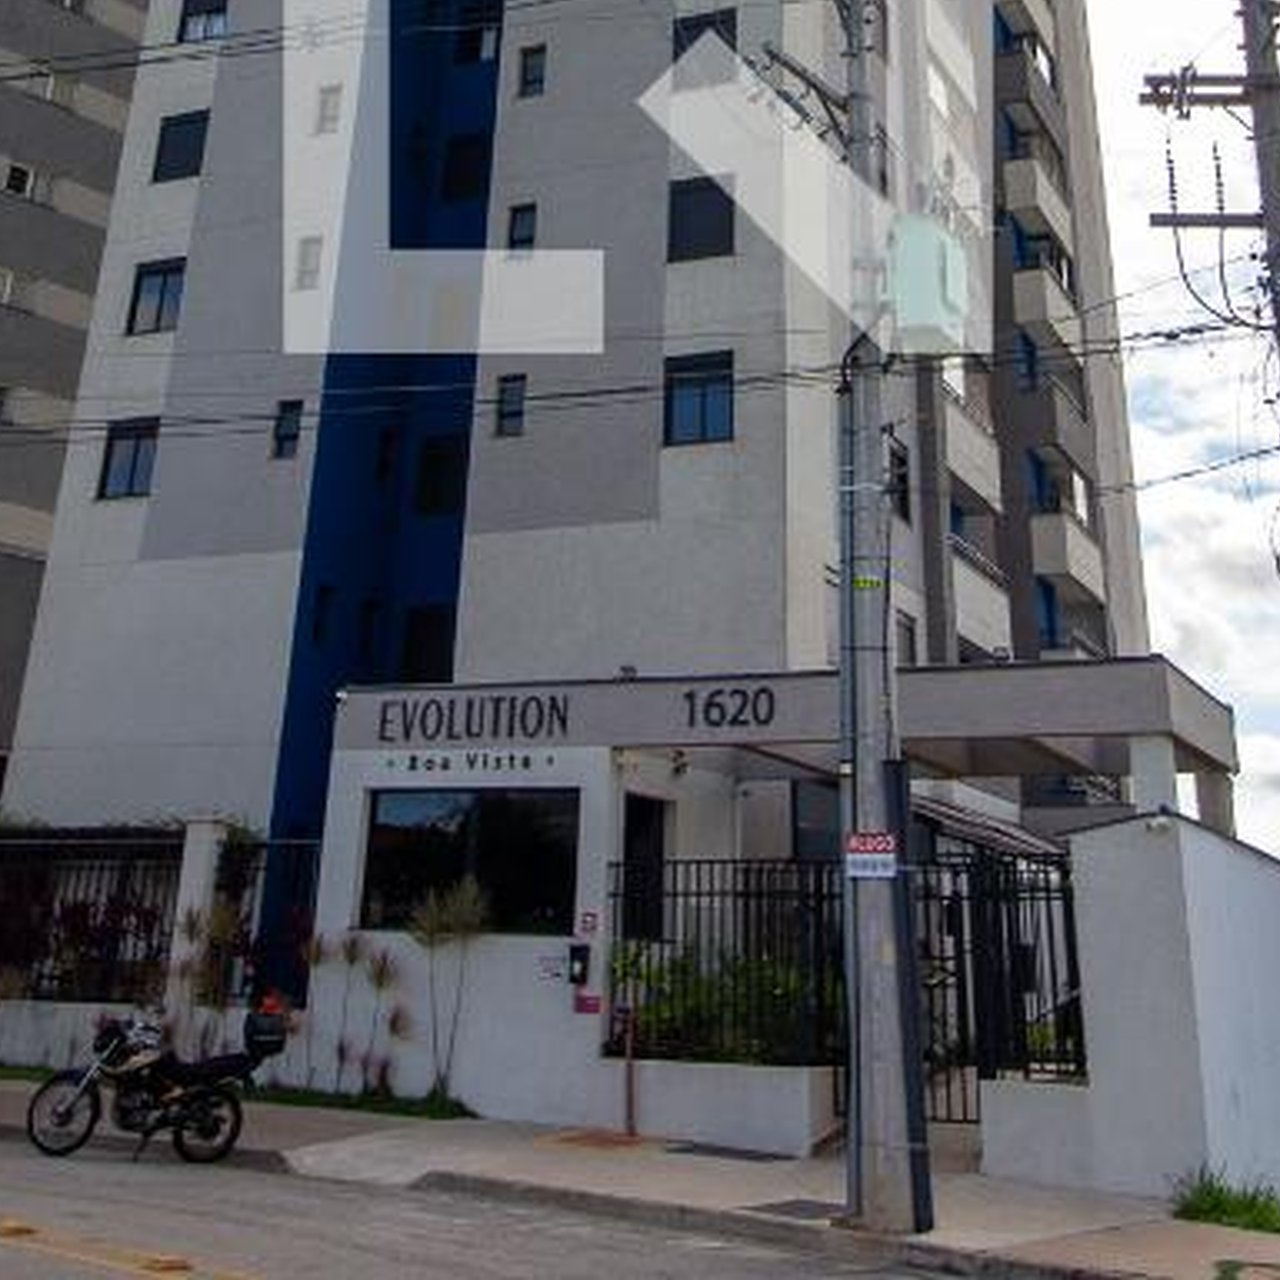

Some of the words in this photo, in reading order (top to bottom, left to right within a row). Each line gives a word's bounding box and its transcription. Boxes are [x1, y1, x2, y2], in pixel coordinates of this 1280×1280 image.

[377, 695, 569, 742] EVOLUTION
[683, 687, 775, 728] 1620
[406, 754, 452, 771] Boa
[465, 752, 532, 771] Vista
